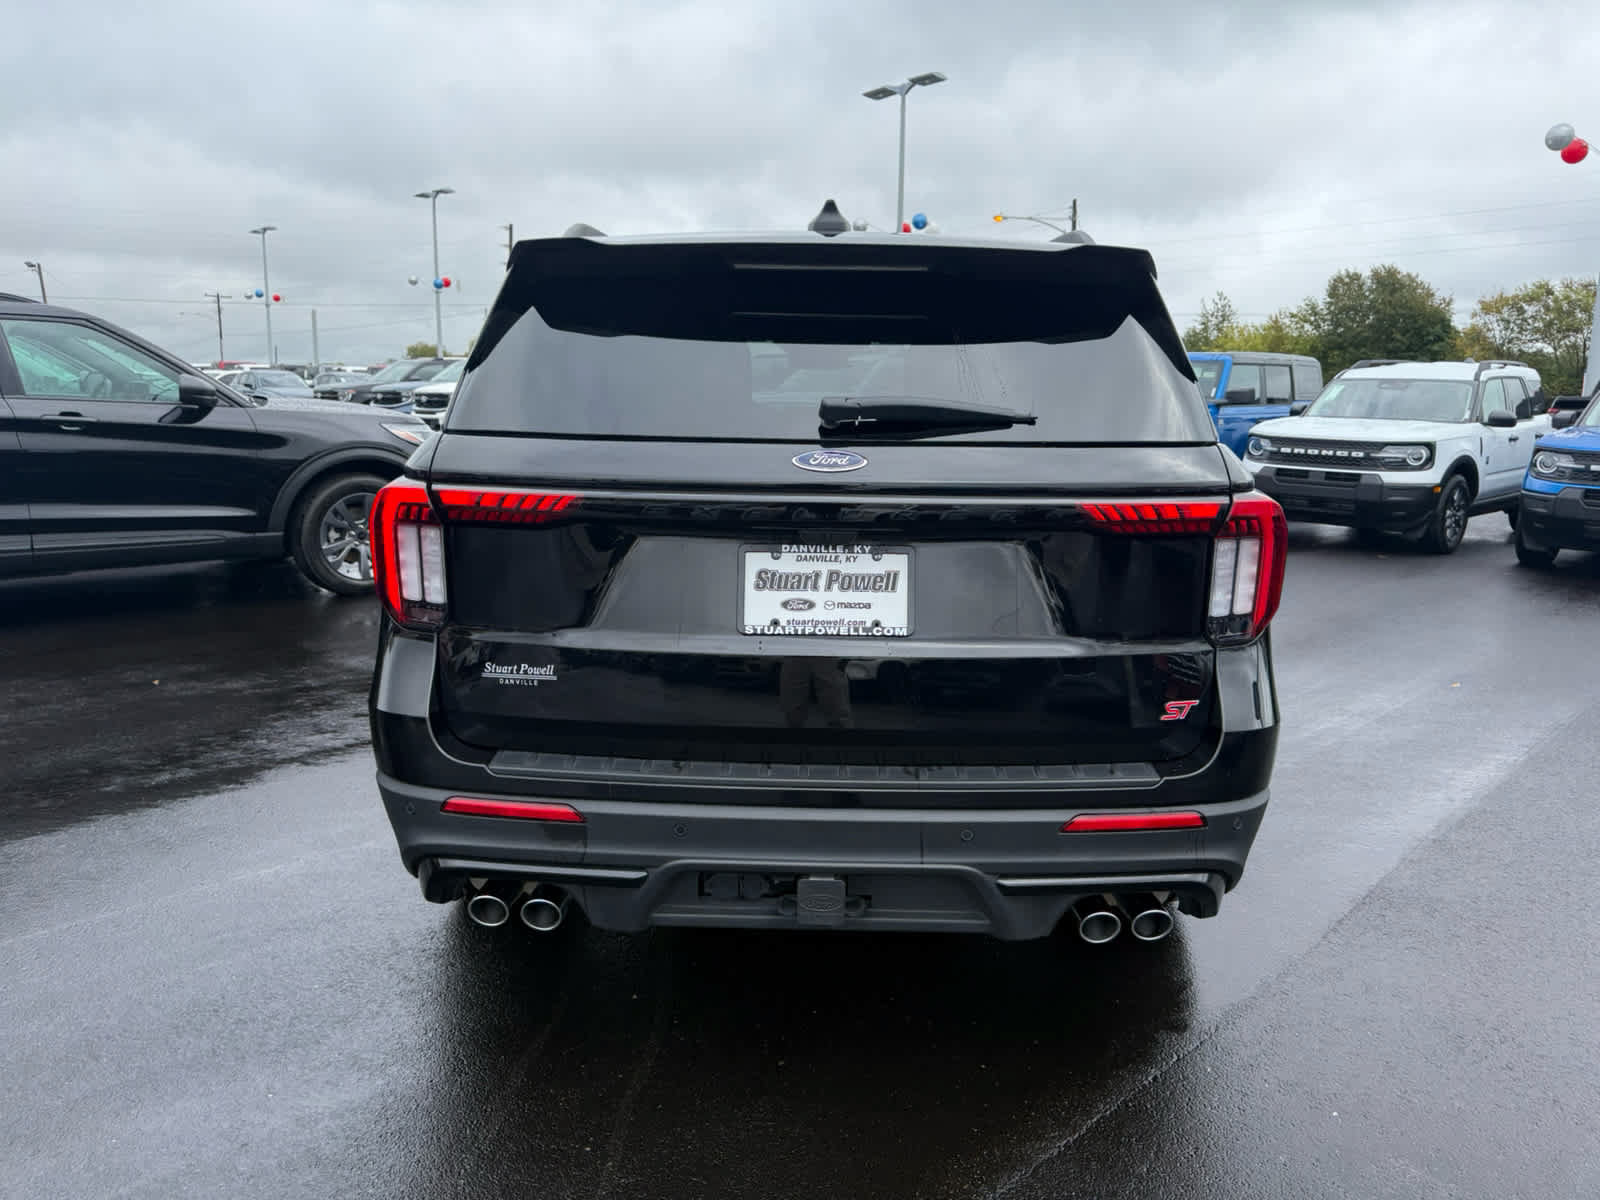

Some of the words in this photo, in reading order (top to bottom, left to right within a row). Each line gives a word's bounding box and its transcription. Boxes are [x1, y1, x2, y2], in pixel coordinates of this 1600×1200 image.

[1280, 447, 1364, 457] BRONCO
[781, 544, 848, 553] DANVILLE,
[854, 545, 871, 553] KY
[796, 555, 841, 564] DANVILLE,
[845, 555, 858, 563] KY
[753, 568, 821, 592] Stuart
[824, 569, 900, 593] Powell
[786, 618, 866, 627] stuartpowell.com
[744, 625, 908, 636] STUARTPOWELL.COM
[483, 661, 518, 674] Stuart
[519, 663, 555, 675] Powell
[499, 678, 538, 686] DANVILLE
[1160, 699, 1200, 720] ST
